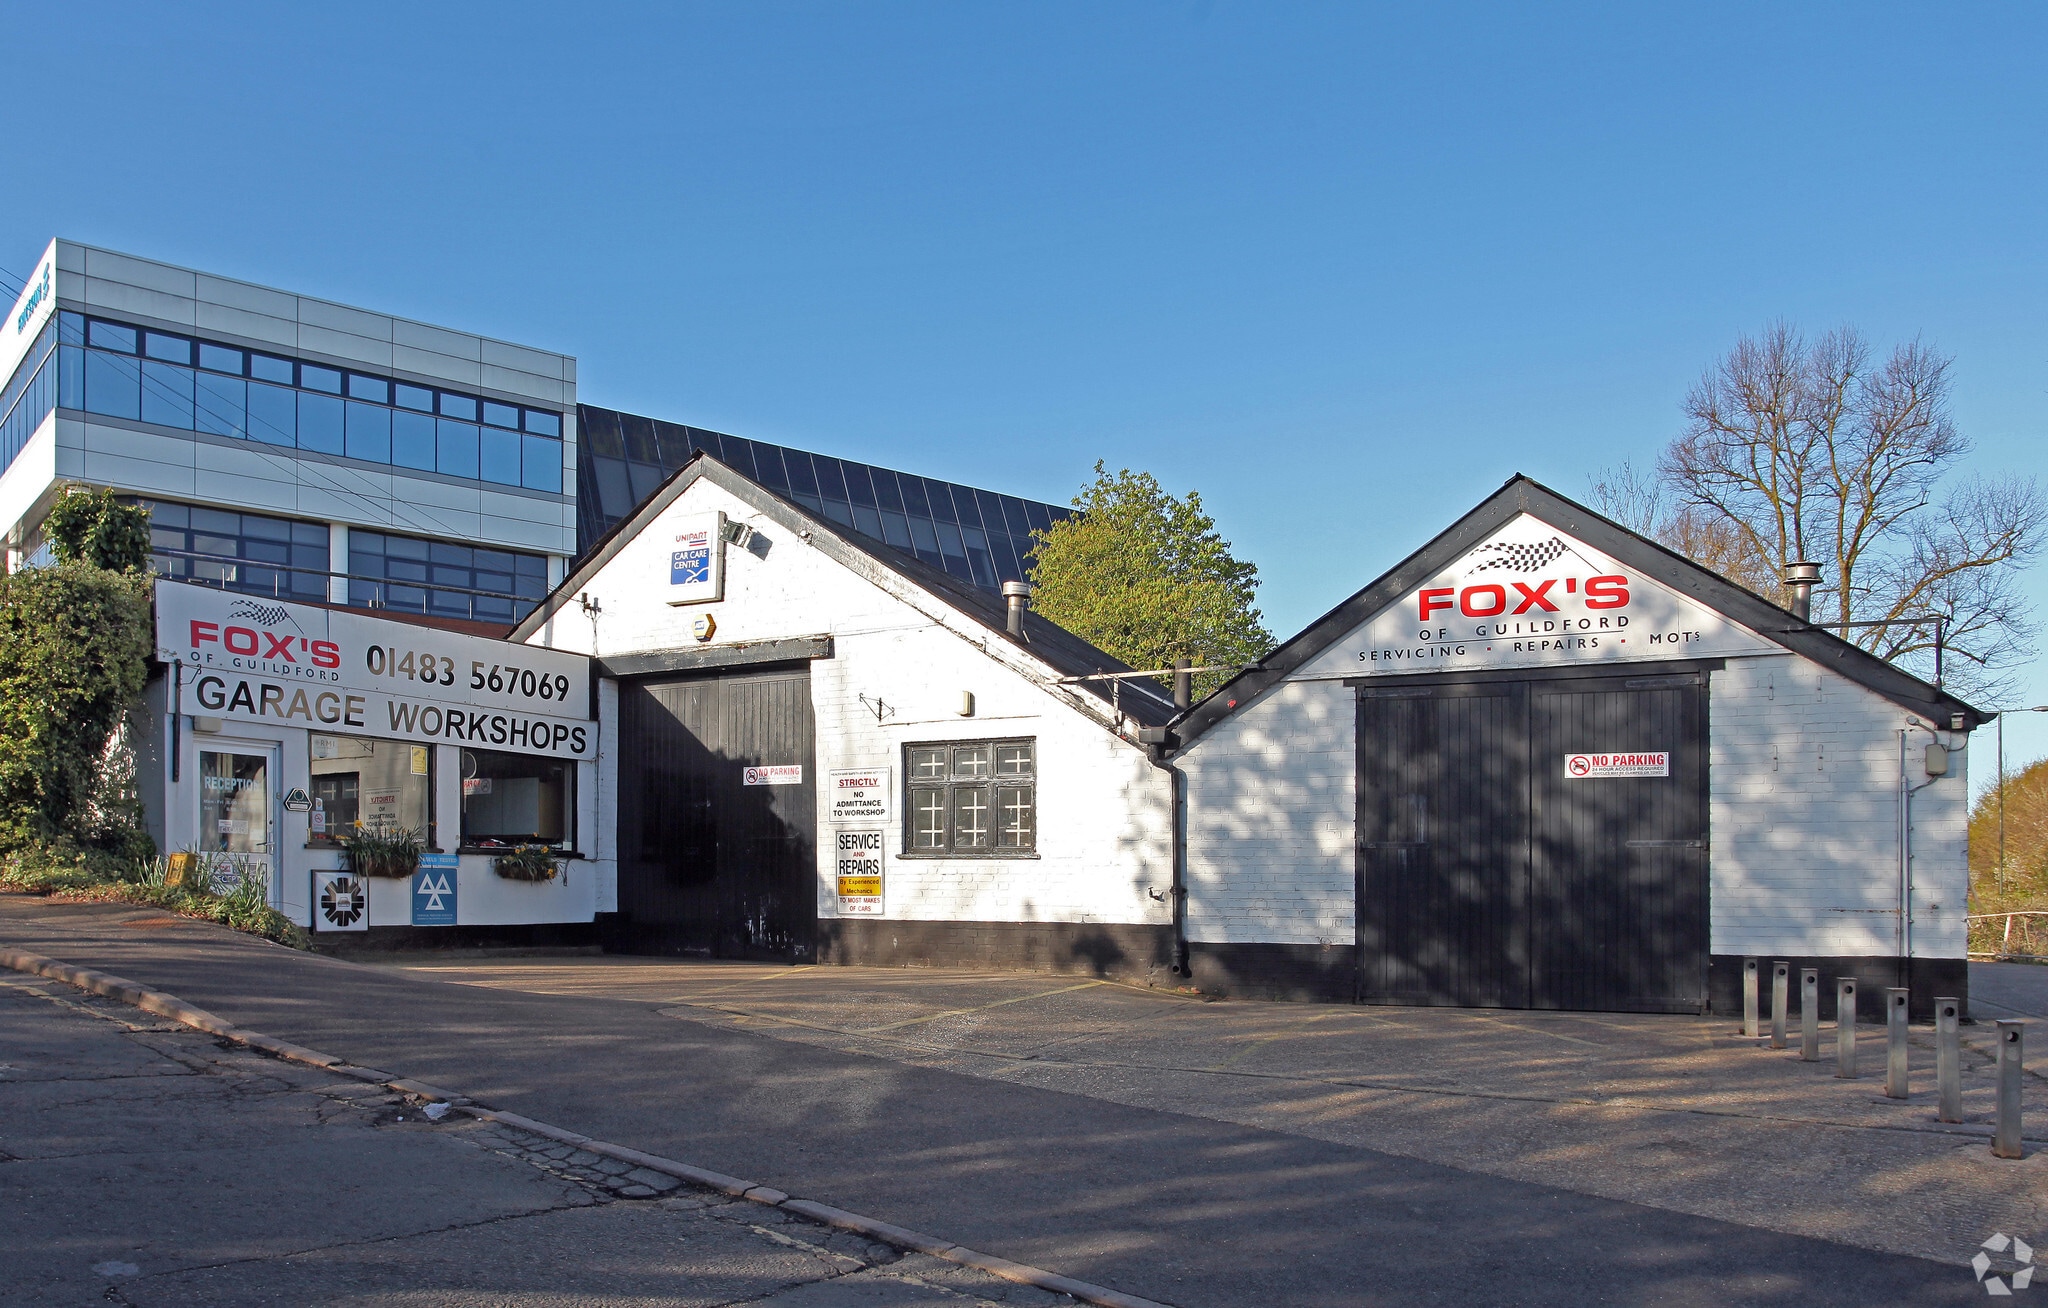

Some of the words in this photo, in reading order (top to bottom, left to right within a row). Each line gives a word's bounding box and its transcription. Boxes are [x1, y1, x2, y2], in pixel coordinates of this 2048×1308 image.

[676, 531, 708, 542] UNIPART
[674, 551, 688, 560] CAR
[690, 549, 707, 559] CARE
[674, 560, 699, 569] CENTRE
[1419, 575, 1630, 621] FOX'S
[1419, 628, 1447, 641] OF
[1476, 616, 1630, 637] GUILDFORD
[190, 620, 340, 668] FOX'S
[1359, 645, 1466, 662] SERVICING
[1514, 637, 1599, 652] REPAIRS
[191, 651, 213, 663] OF
[233, 658, 339, 681] GUILDFORD
[366, 645, 455, 686] 01483
[470, 661, 569, 702] 567069
[197, 676, 366, 728] GARAGE
[387, 701, 587, 754] WORKSHOPS
[1592, 755, 1608, 766] NO
[1613, 754, 1664, 766] PARKING
[759, 768, 768, 776] NO
[770, 767, 800, 775] PARKING
[839, 778, 878, 786] STRICTLY
[839, 834, 880, 850] SERVICE
[839, 859, 879, 875] REPAIRS
